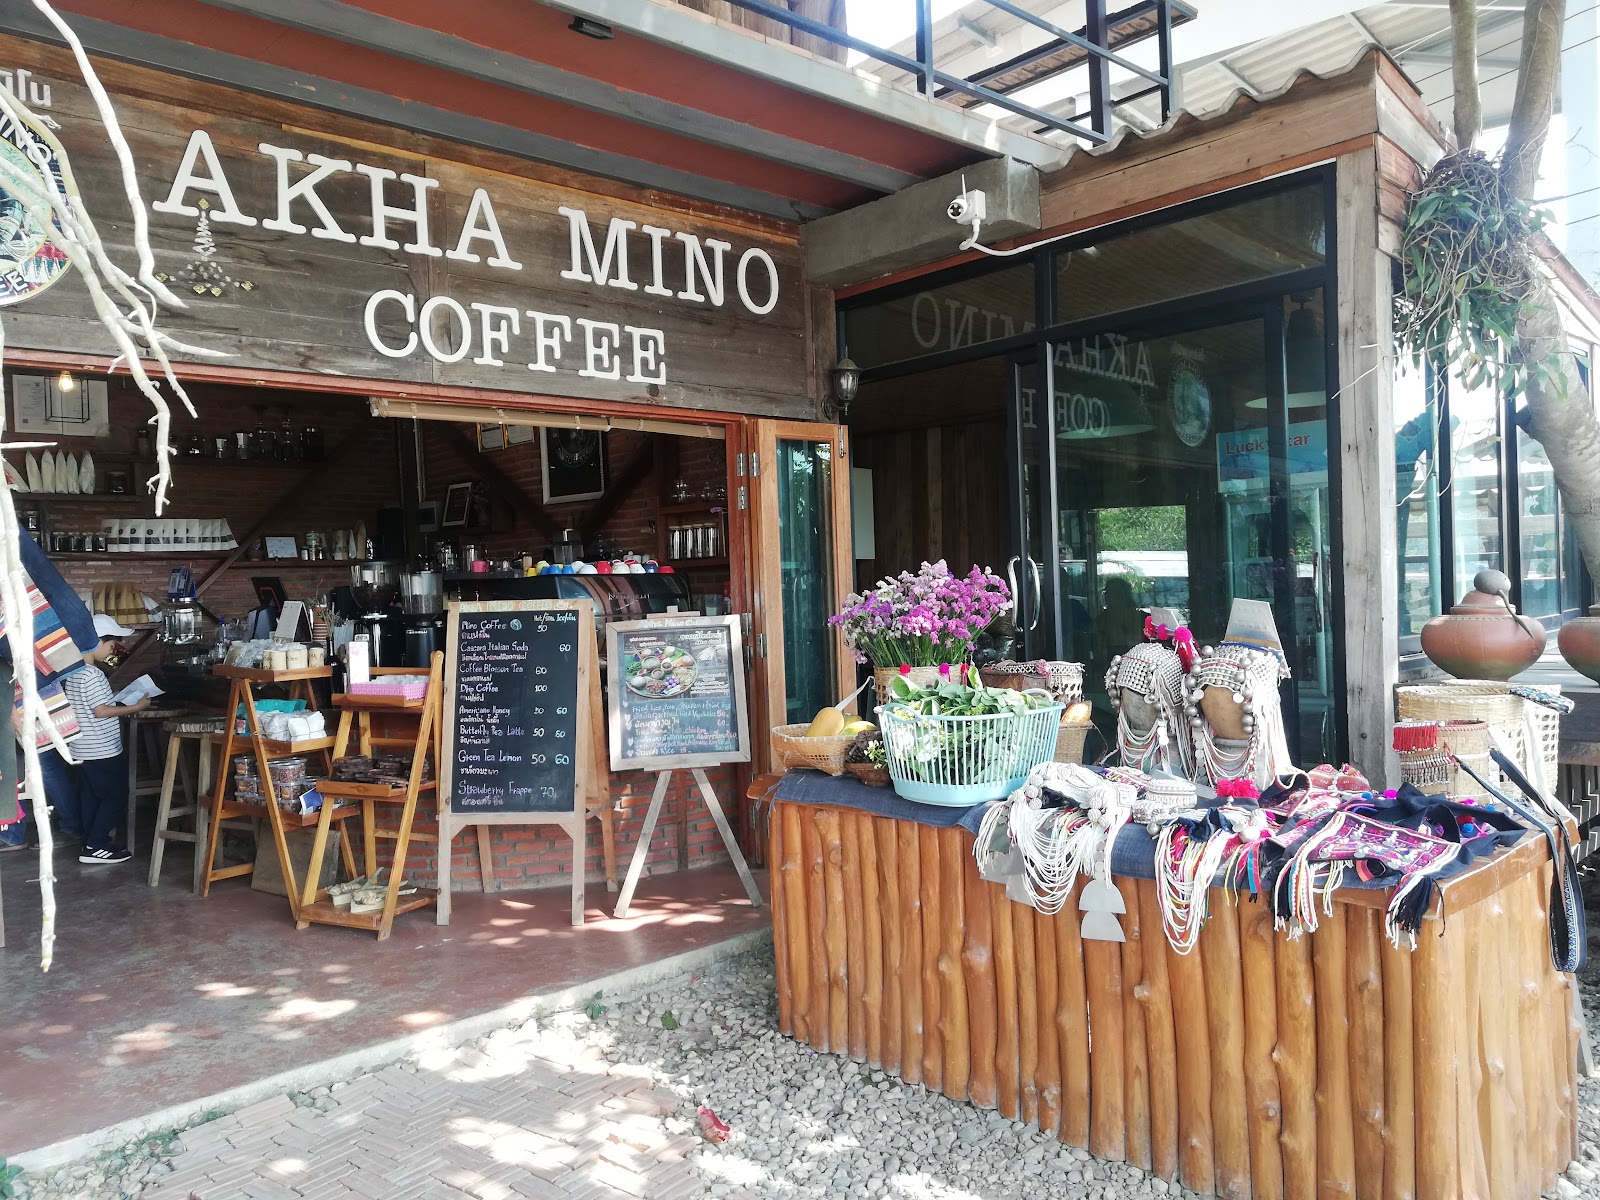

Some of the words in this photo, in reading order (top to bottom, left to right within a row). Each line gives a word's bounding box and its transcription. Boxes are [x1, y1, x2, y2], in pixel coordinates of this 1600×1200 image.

[152, 129, 523, 271] AKHA
[558, 205, 781, 316] MINO
[363, 288, 668, 387] COFFEE
[511, 640, 529, 651] Soda
[534, 684, 548, 692] 100
[556, 707, 568, 715] 60
[460, 724, 489, 737] Butterfly
[532, 728, 545, 737] 50
[458, 749, 480, 763] Green
[483, 748, 495, 762] Tea
[498, 750, 522, 762] Lemon
[531, 753, 546, 765] 50
[554, 753, 570, 765] 60
[458, 780, 504, 797] Strawberry
